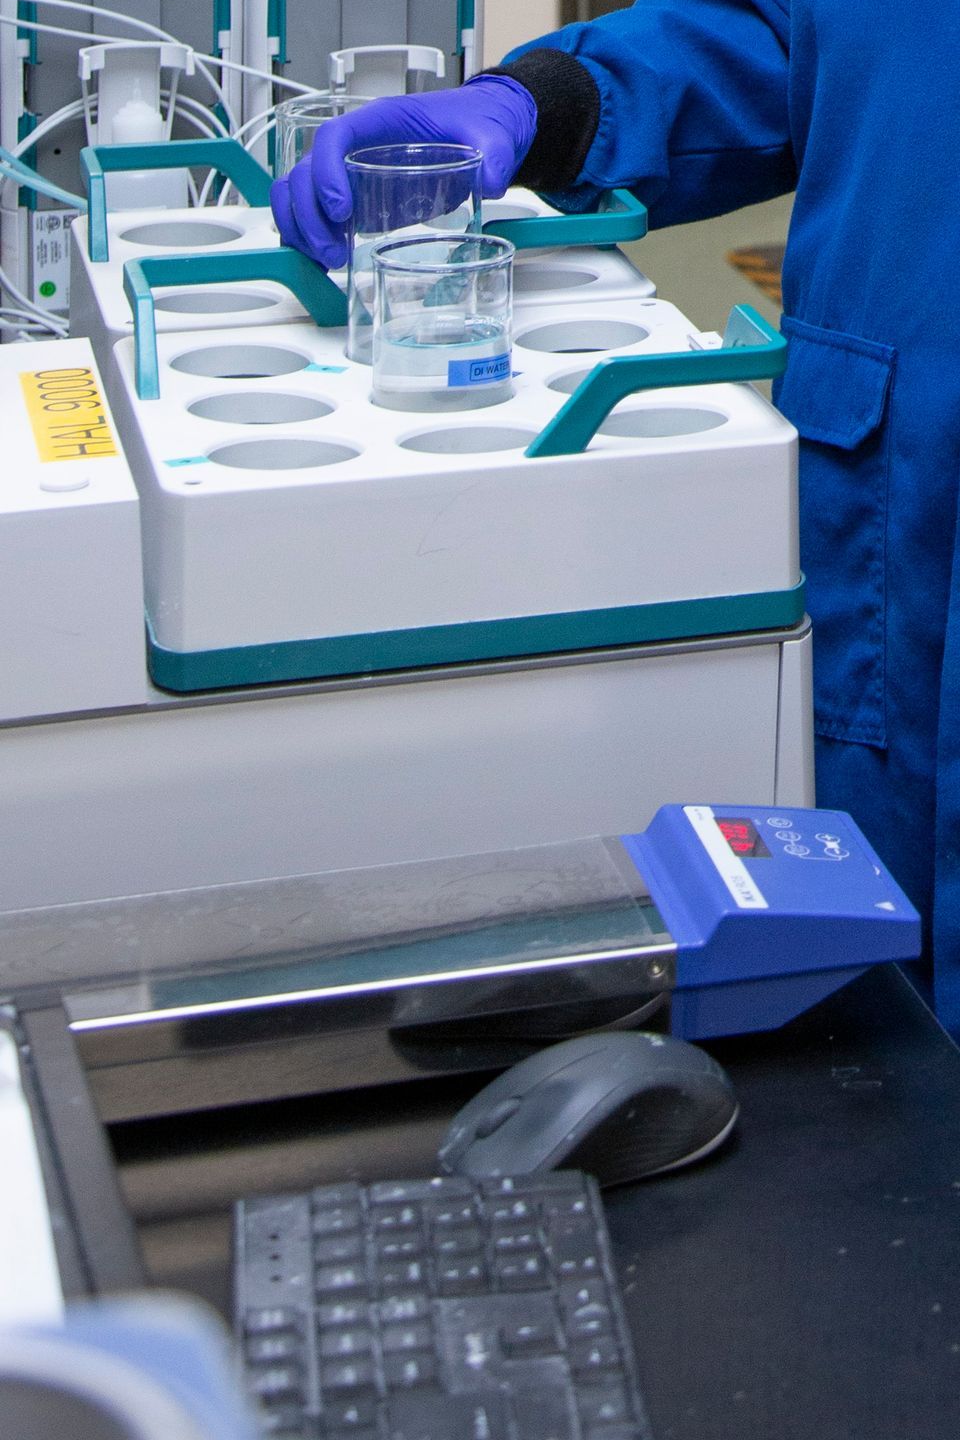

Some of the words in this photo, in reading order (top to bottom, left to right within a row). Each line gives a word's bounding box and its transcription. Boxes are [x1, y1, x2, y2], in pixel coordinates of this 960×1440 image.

[34, 368, 101, 412] 9000
[474, 367, 484, 377] DI
[48, 416, 116, 458] HAL
